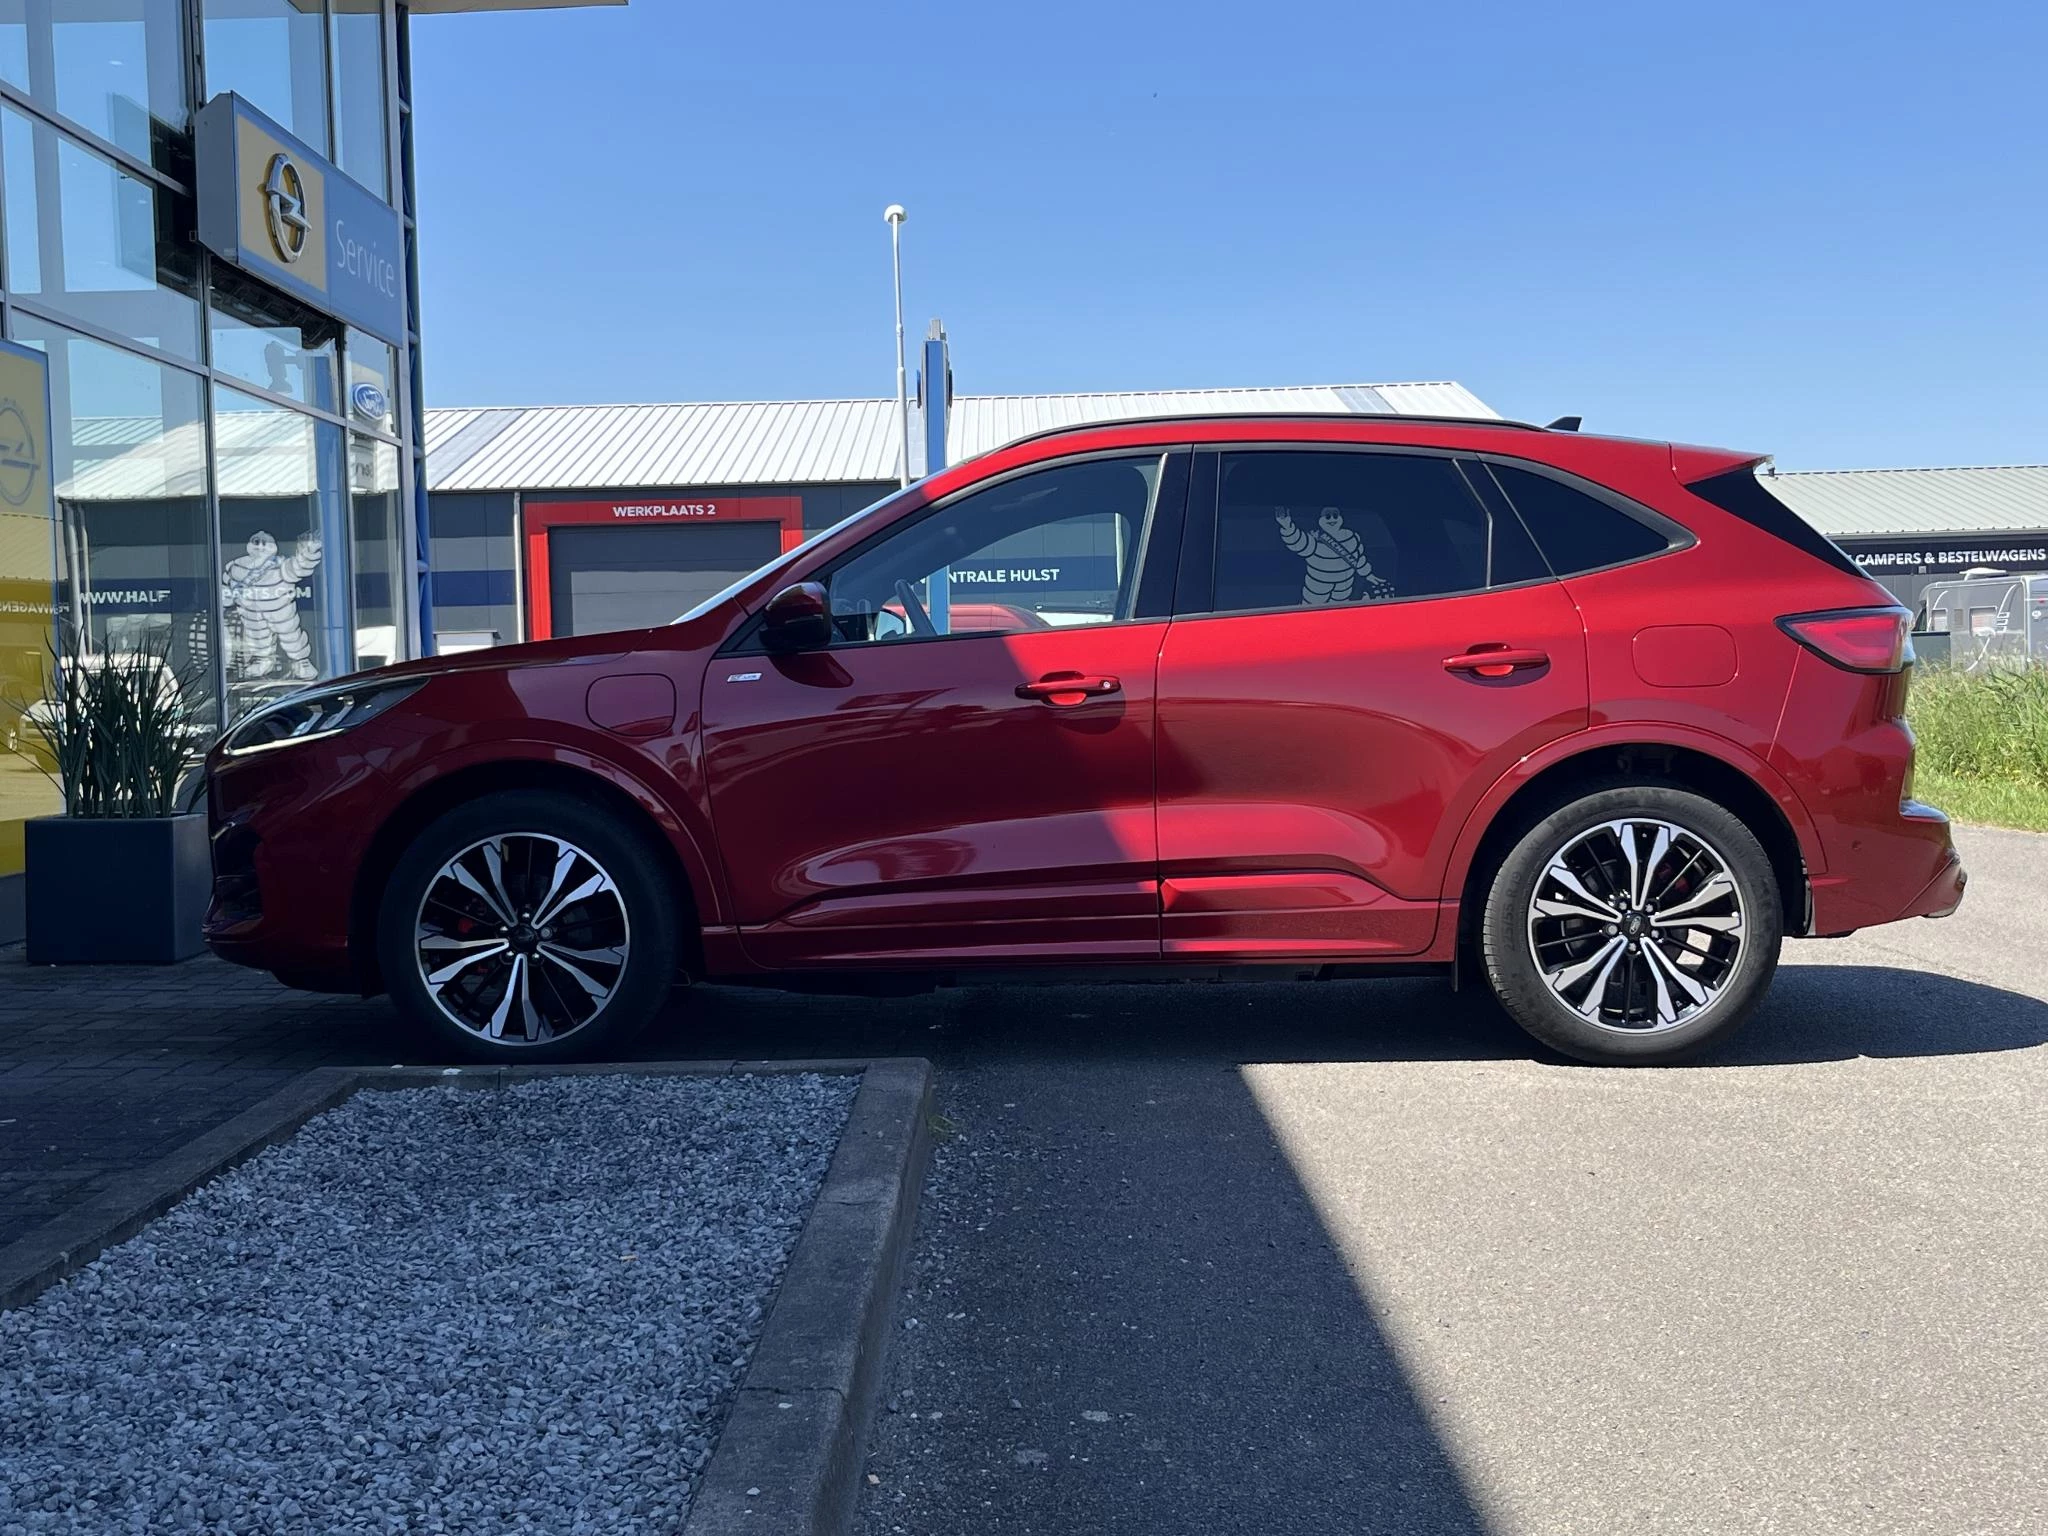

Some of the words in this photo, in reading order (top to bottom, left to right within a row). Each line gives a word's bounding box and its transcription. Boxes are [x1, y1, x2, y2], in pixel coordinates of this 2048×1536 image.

[336, 219, 394, 298] Service
[613, 504, 704, 517] WERKPLAATS
[707, 504, 716, 515] 2
[1855, 551, 1921, 566] CAMPERS
[1924, 551, 1935, 564] &
[1938, 548, 2046, 564] BESTELWAGENS
[1010, 569, 1060, 582] HULST
